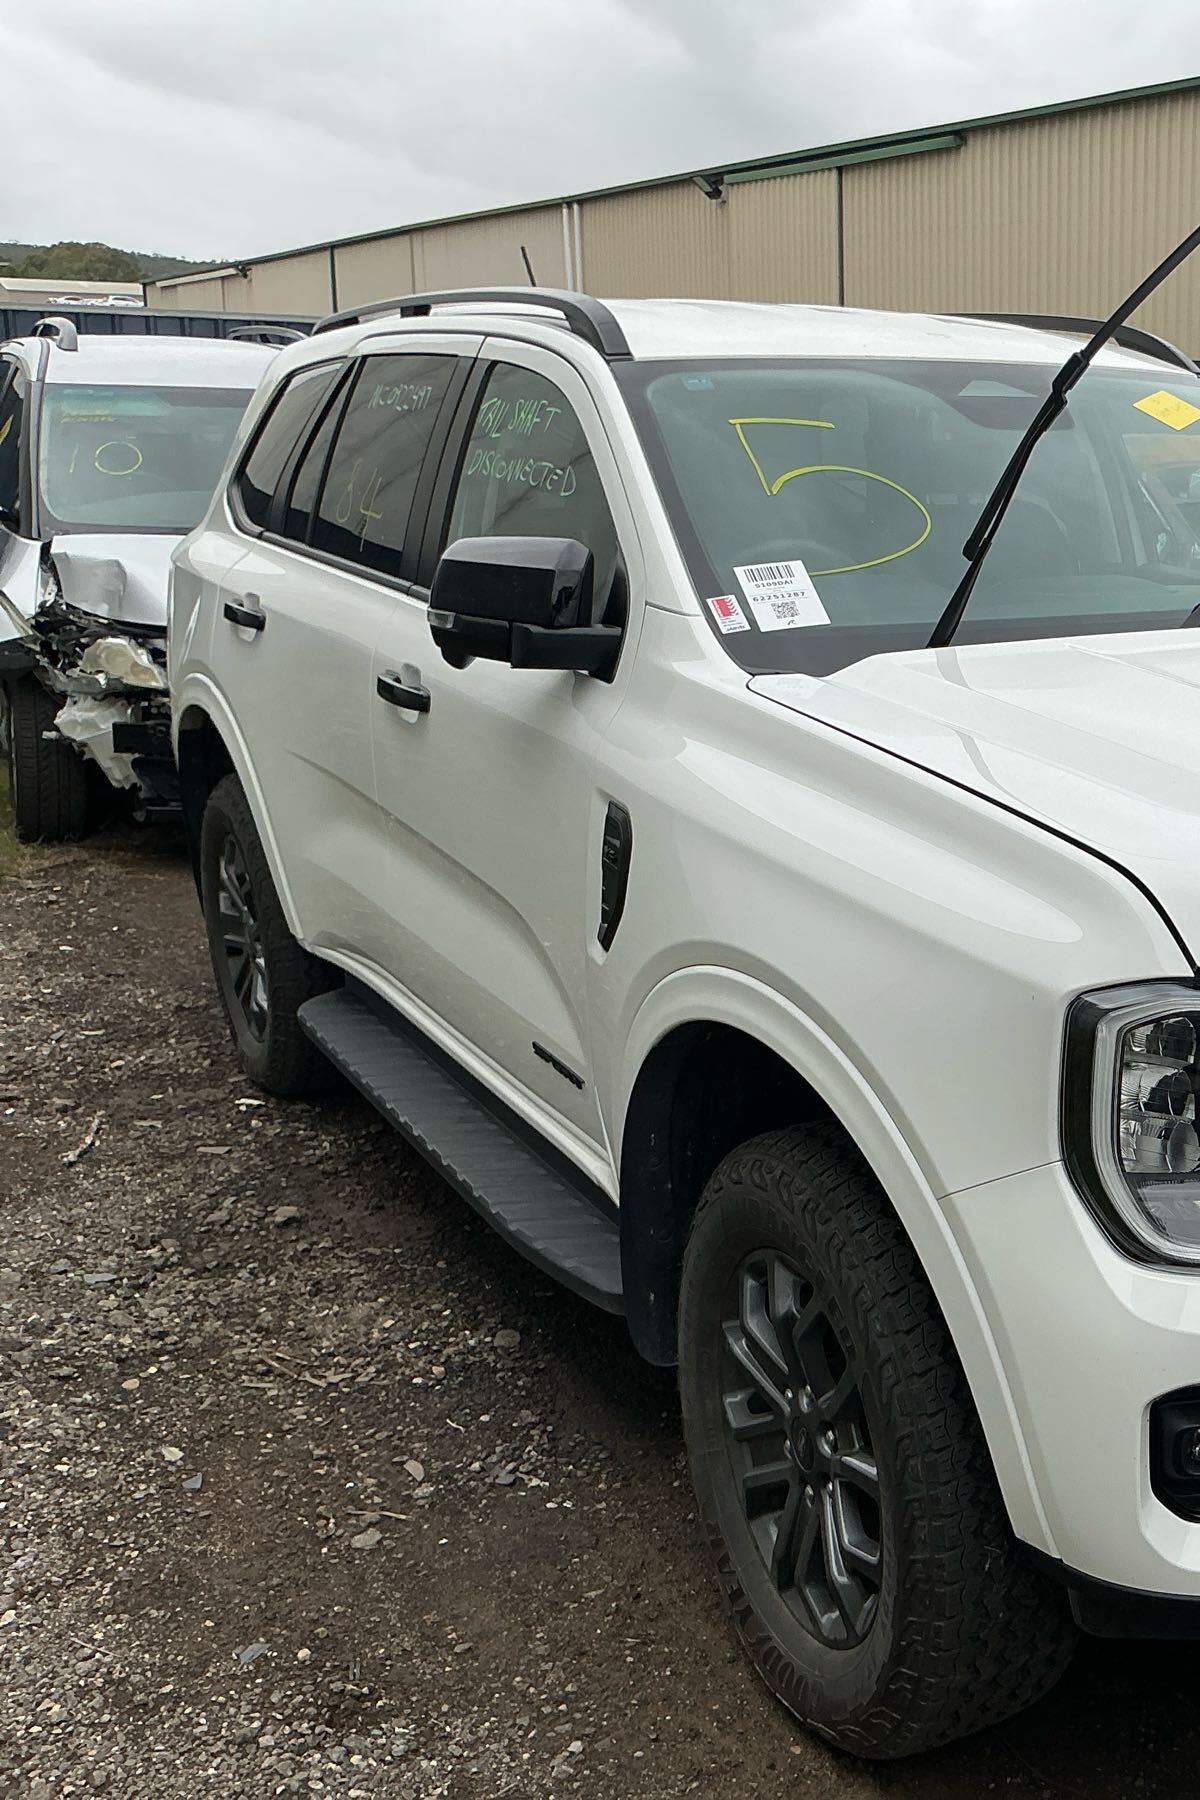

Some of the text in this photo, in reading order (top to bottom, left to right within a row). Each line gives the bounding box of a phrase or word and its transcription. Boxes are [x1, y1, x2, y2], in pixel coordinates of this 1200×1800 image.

[507, 399, 562, 436] SHAFT
[467, 448, 577, 497] DISCONNECTED
[727, 417, 932, 577] 5
[752, 591, 806, 602] 62251287
[754, 579, 794, 589] S109DAI
